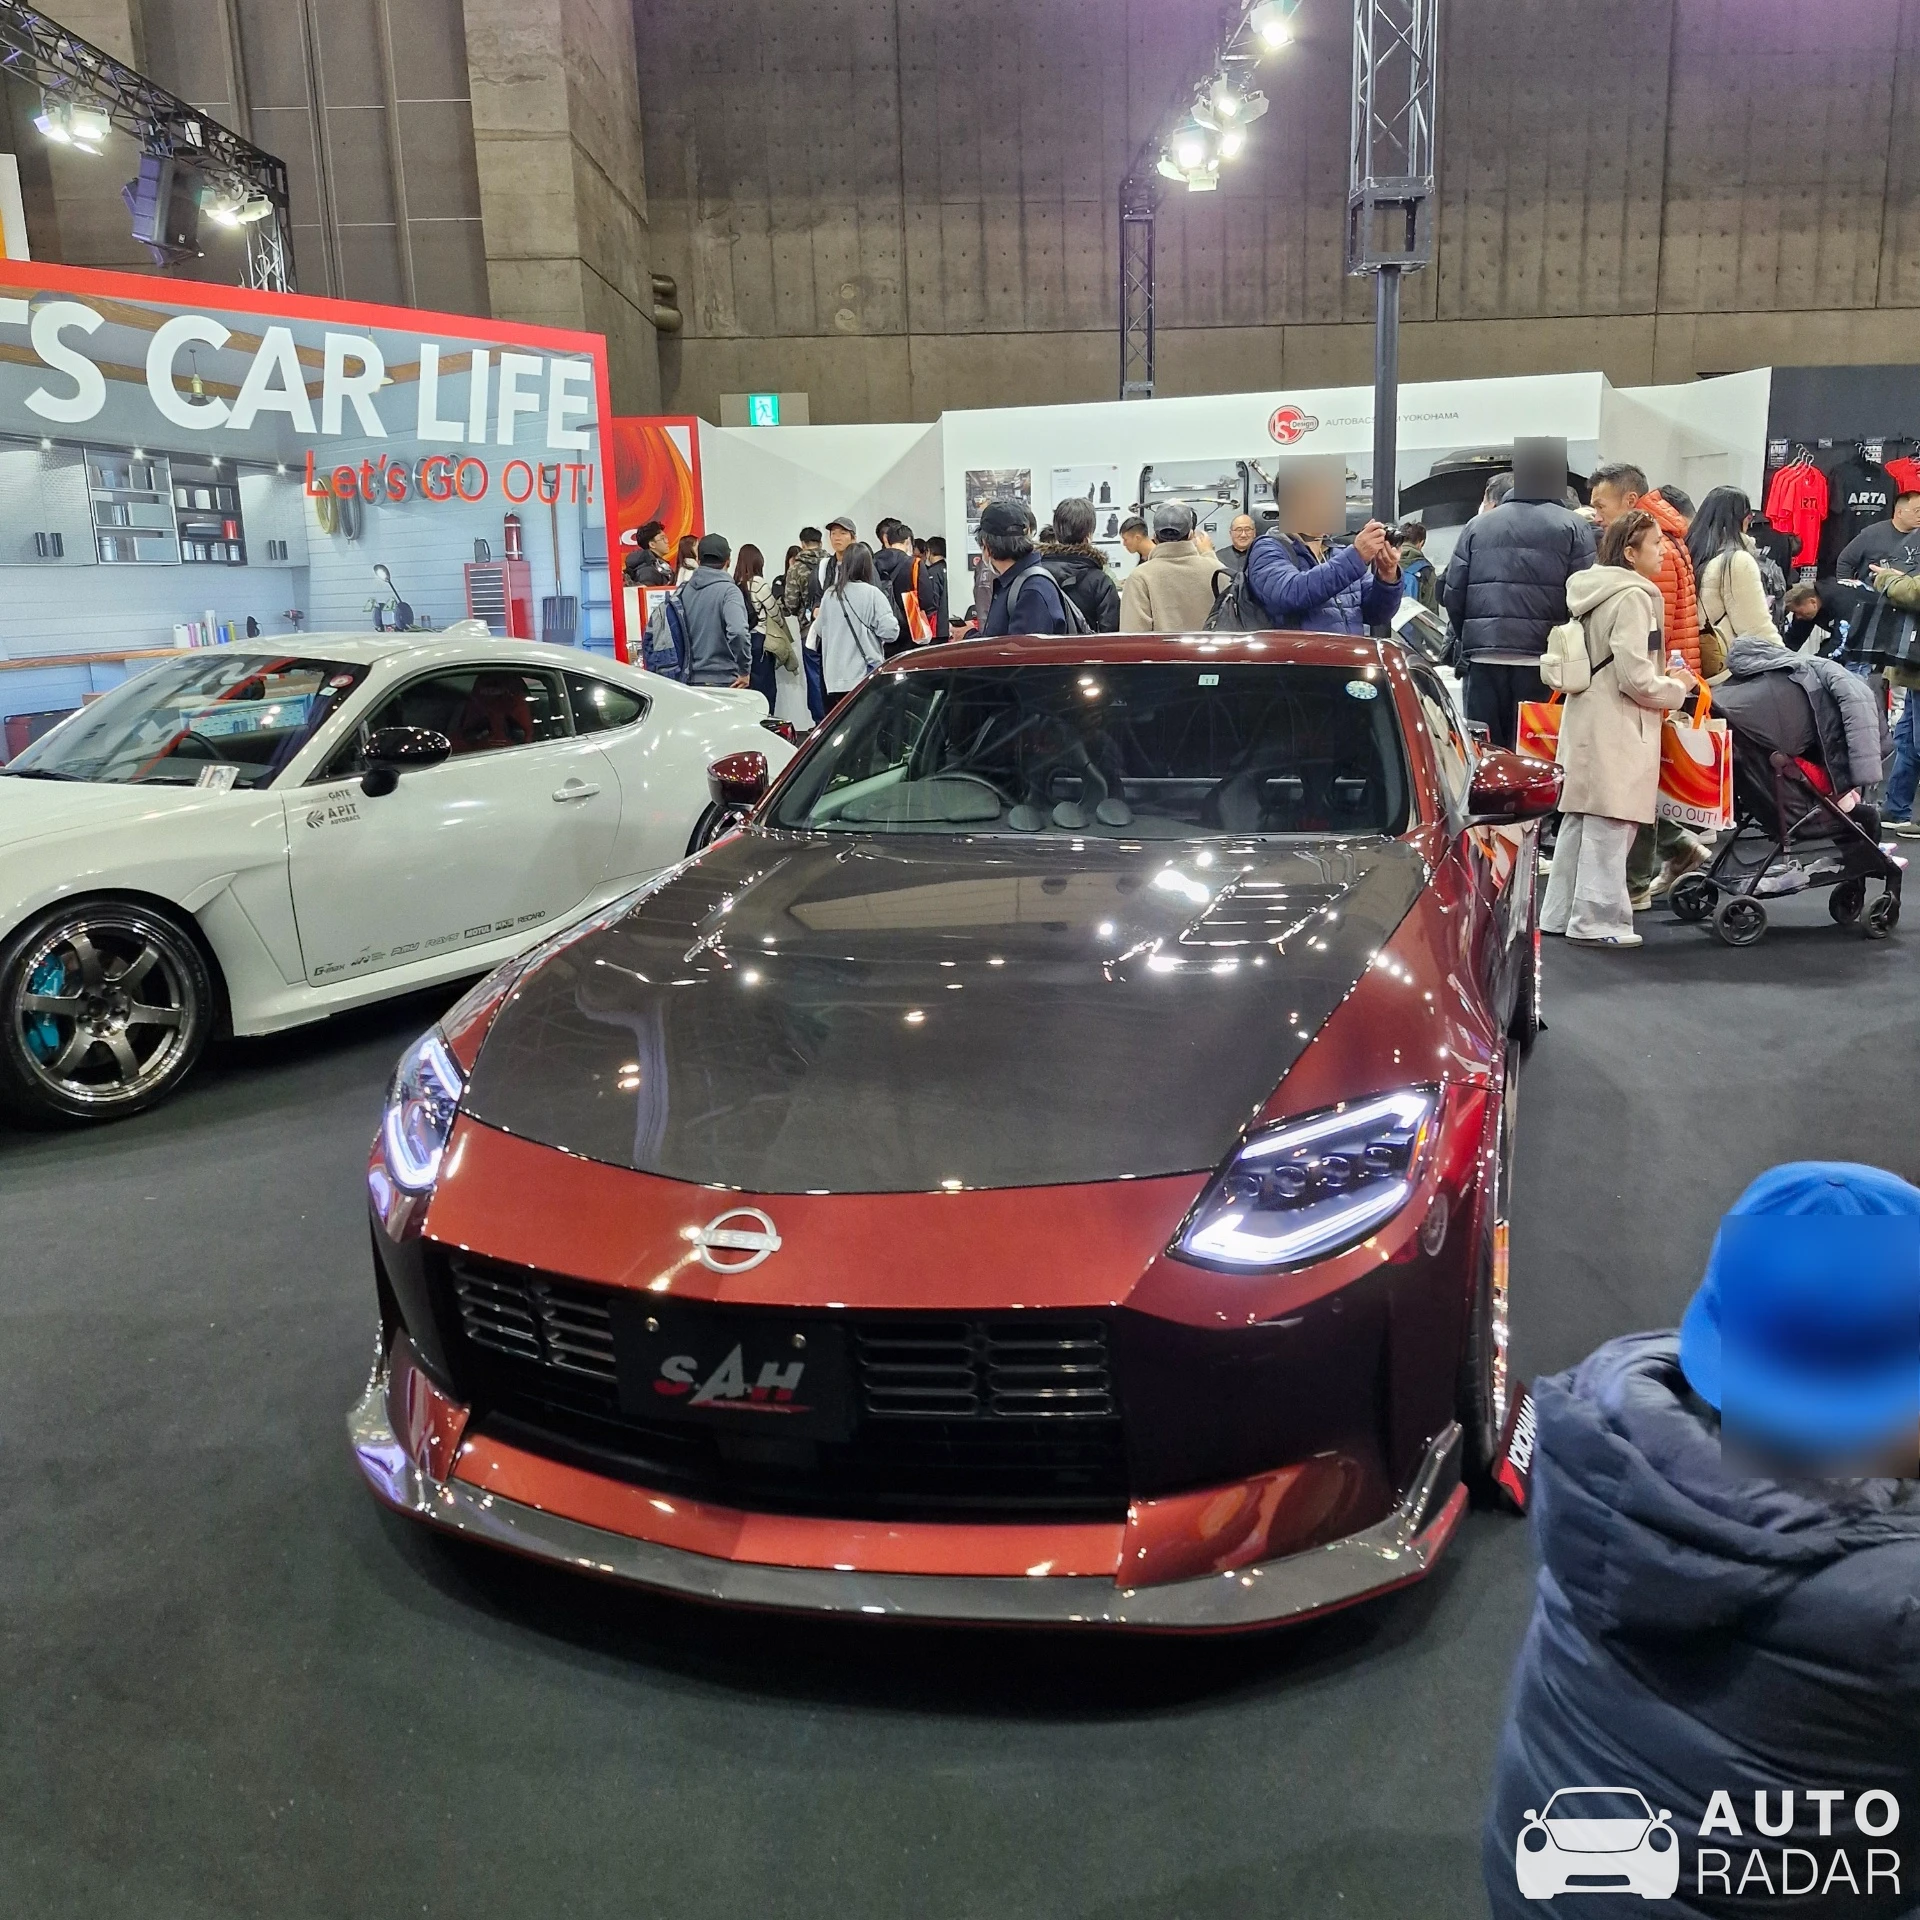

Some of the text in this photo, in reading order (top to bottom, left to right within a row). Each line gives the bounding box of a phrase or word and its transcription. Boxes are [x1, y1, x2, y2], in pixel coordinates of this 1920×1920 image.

[146, 314, 388, 438] CAR
[417, 342, 592, 450] LIFE
[1402, 412, 1459, 422] YOKOHAMA
[305, 449, 593, 505] Let's GO OUT!
[1848, 492, 1887, 505] ARTA
[328, 789, 351, 799] GATE
[1662, 803, 1682, 818] GO
[1686, 808, 1717, 825] OUT!
[465, 925, 491, 937] MOTUL
[518, 911, 546, 923] RECARO
[699, 1231, 778, 1249] NISSAN
